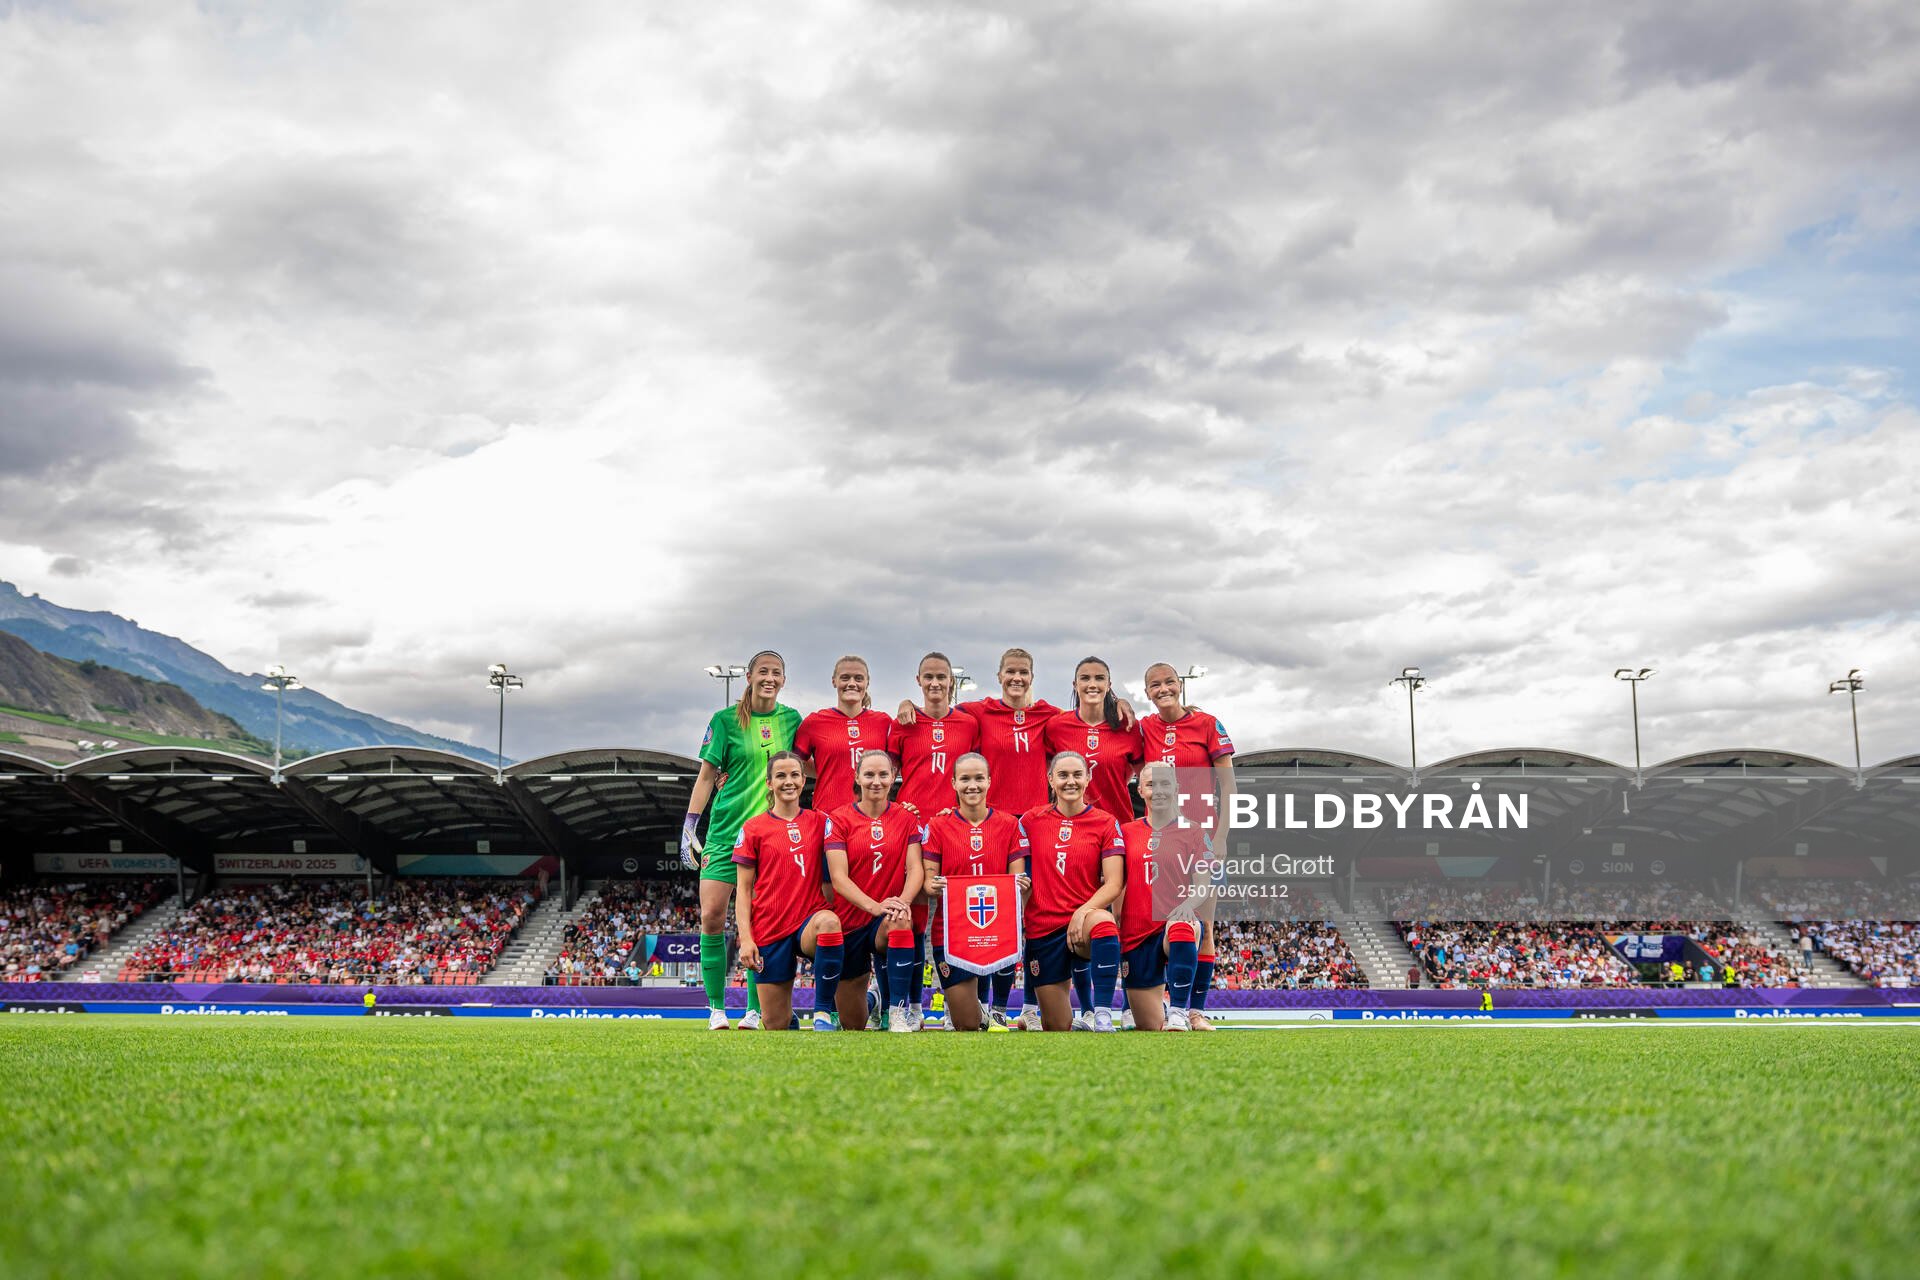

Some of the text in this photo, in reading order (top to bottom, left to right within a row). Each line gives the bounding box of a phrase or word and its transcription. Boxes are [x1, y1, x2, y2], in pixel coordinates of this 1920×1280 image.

[1014, 731, 1029, 753] 14
[931, 752, 946, 774] 10
[78, 858, 109, 869] UEFA
[218, 858, 337, 869] SWITZERLAND 2025
[793, 853, 806, 877] 4
[872, 851, 883, 875] 2
[1055, 851, 1067, 876] 8
[1601, 862, 1634, 873] SION
[667, 943, 702, 955] C2-C
